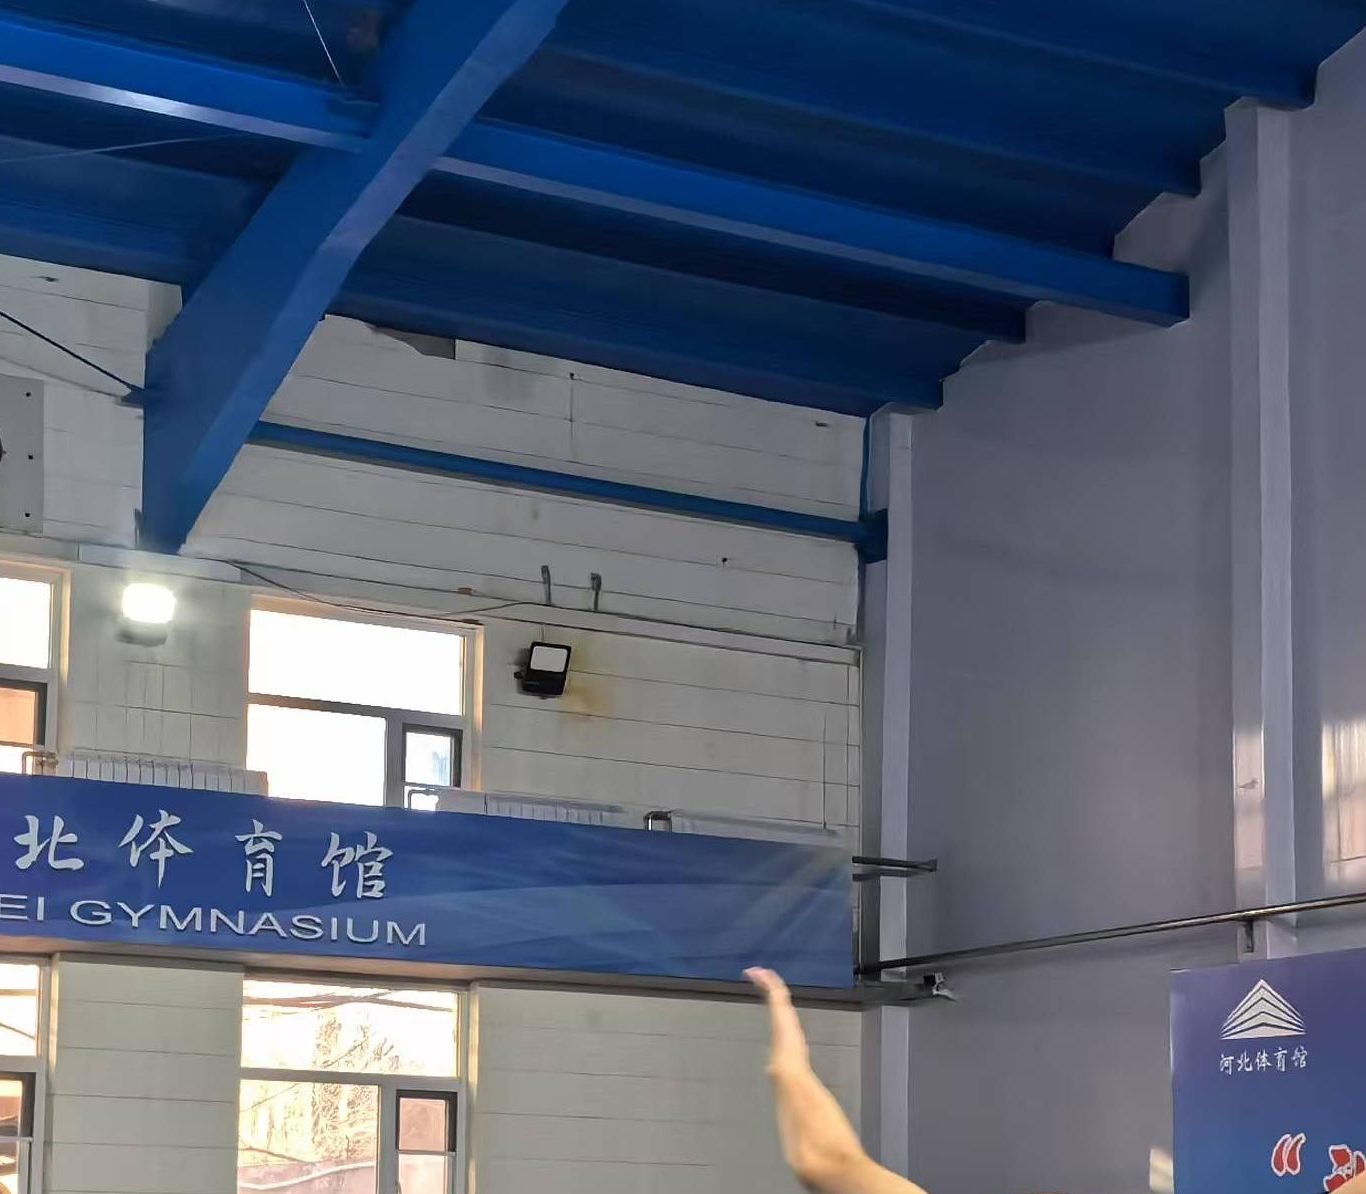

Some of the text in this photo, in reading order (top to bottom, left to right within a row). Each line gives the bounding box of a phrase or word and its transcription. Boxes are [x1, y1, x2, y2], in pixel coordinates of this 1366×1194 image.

[69, 899, 427, 946] GYMNASIUM
[1220, 1045, 1308, 1075] 河北体育馆
